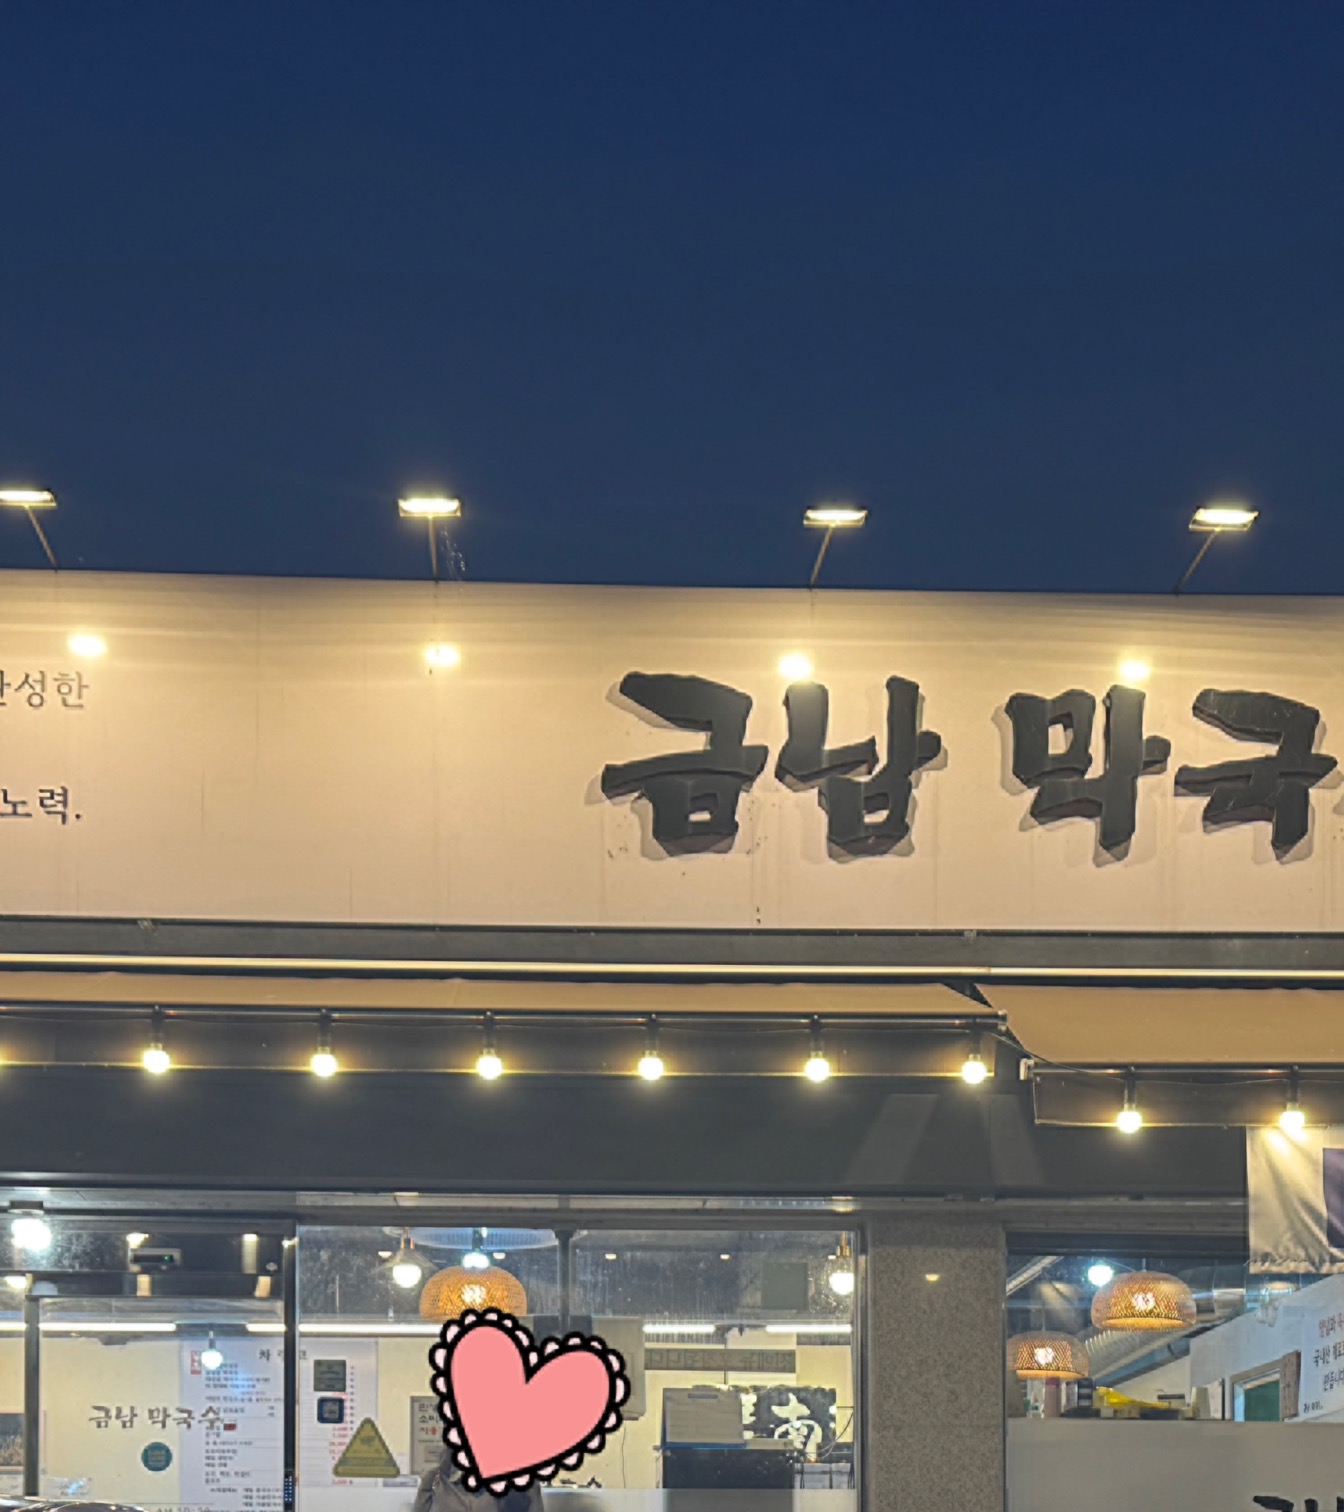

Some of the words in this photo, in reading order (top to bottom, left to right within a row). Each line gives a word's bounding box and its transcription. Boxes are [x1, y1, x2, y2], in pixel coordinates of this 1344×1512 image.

[600, 671, 942, 856] 금남
[88, 1405, 138, 1429] 금남
[147, 1405, 220, 1430] 막국수
